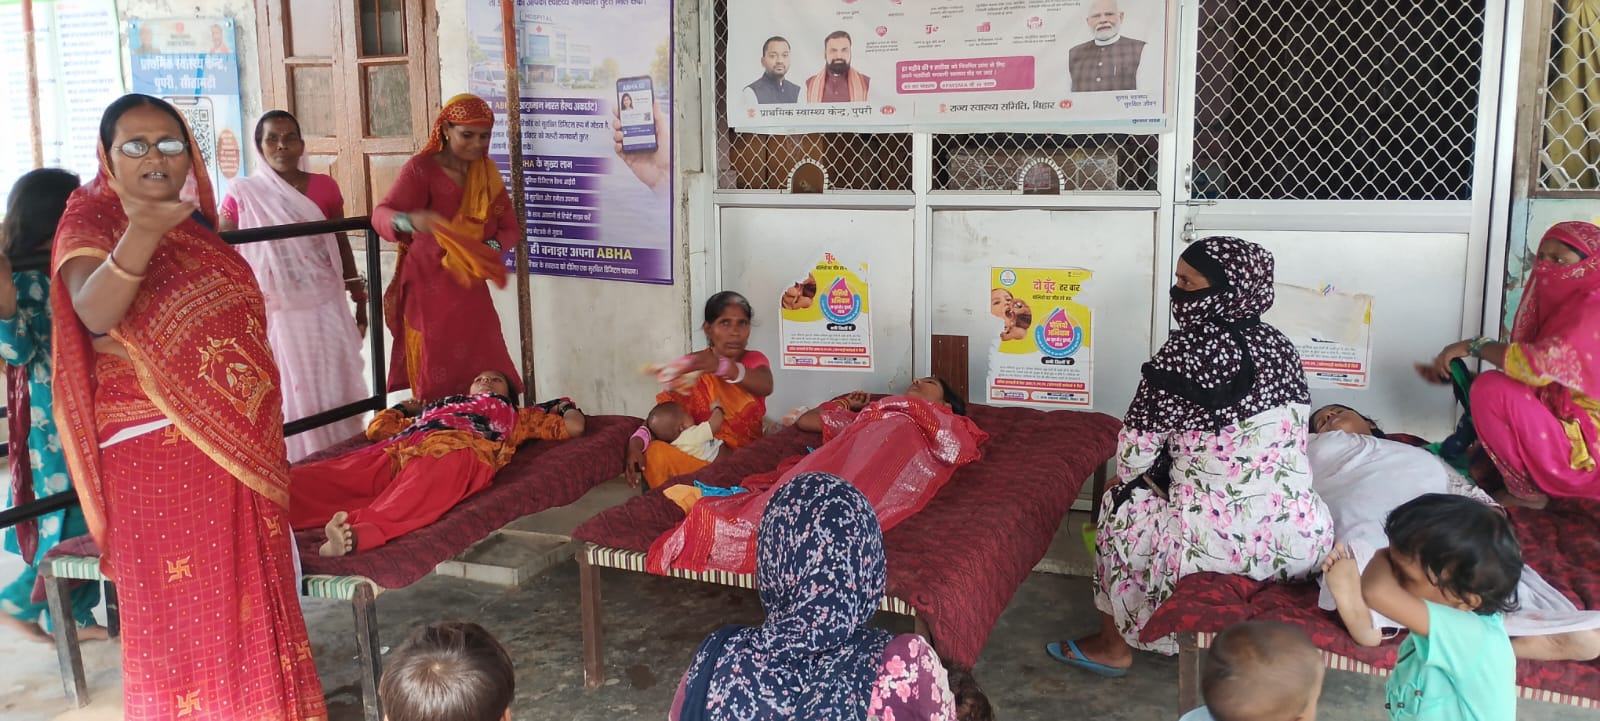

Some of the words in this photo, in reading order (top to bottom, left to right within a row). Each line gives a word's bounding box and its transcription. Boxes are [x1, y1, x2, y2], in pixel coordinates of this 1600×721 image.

[560, 100, 572, 110] हेल्थ
[950, 104, 967, 112] राज्य
[970, 103, 999, 112] स्वास्थ्य
[1001, 100, 1029, 111] समिति,
[1032, 101, 1055, 110] बिहार
[760, 106, 793, 117] प्राथमिक
[796, 108, 825, 116] स्वास्थ्य
[828, 105, 850, 117] केन्द्र,
[852, 106, 872, 118] पुपरी
[536, 157, 542, 167] के
[530, 243, 539, 254] ही
[542, 246, 568, 257] बनाइए
[570, 247, 594, 258] अपना
[597, 248, 632, 260] ABHA
[1033, 279, 1042, 290] दो
[1043, 277, 1056, 294] बूँद
